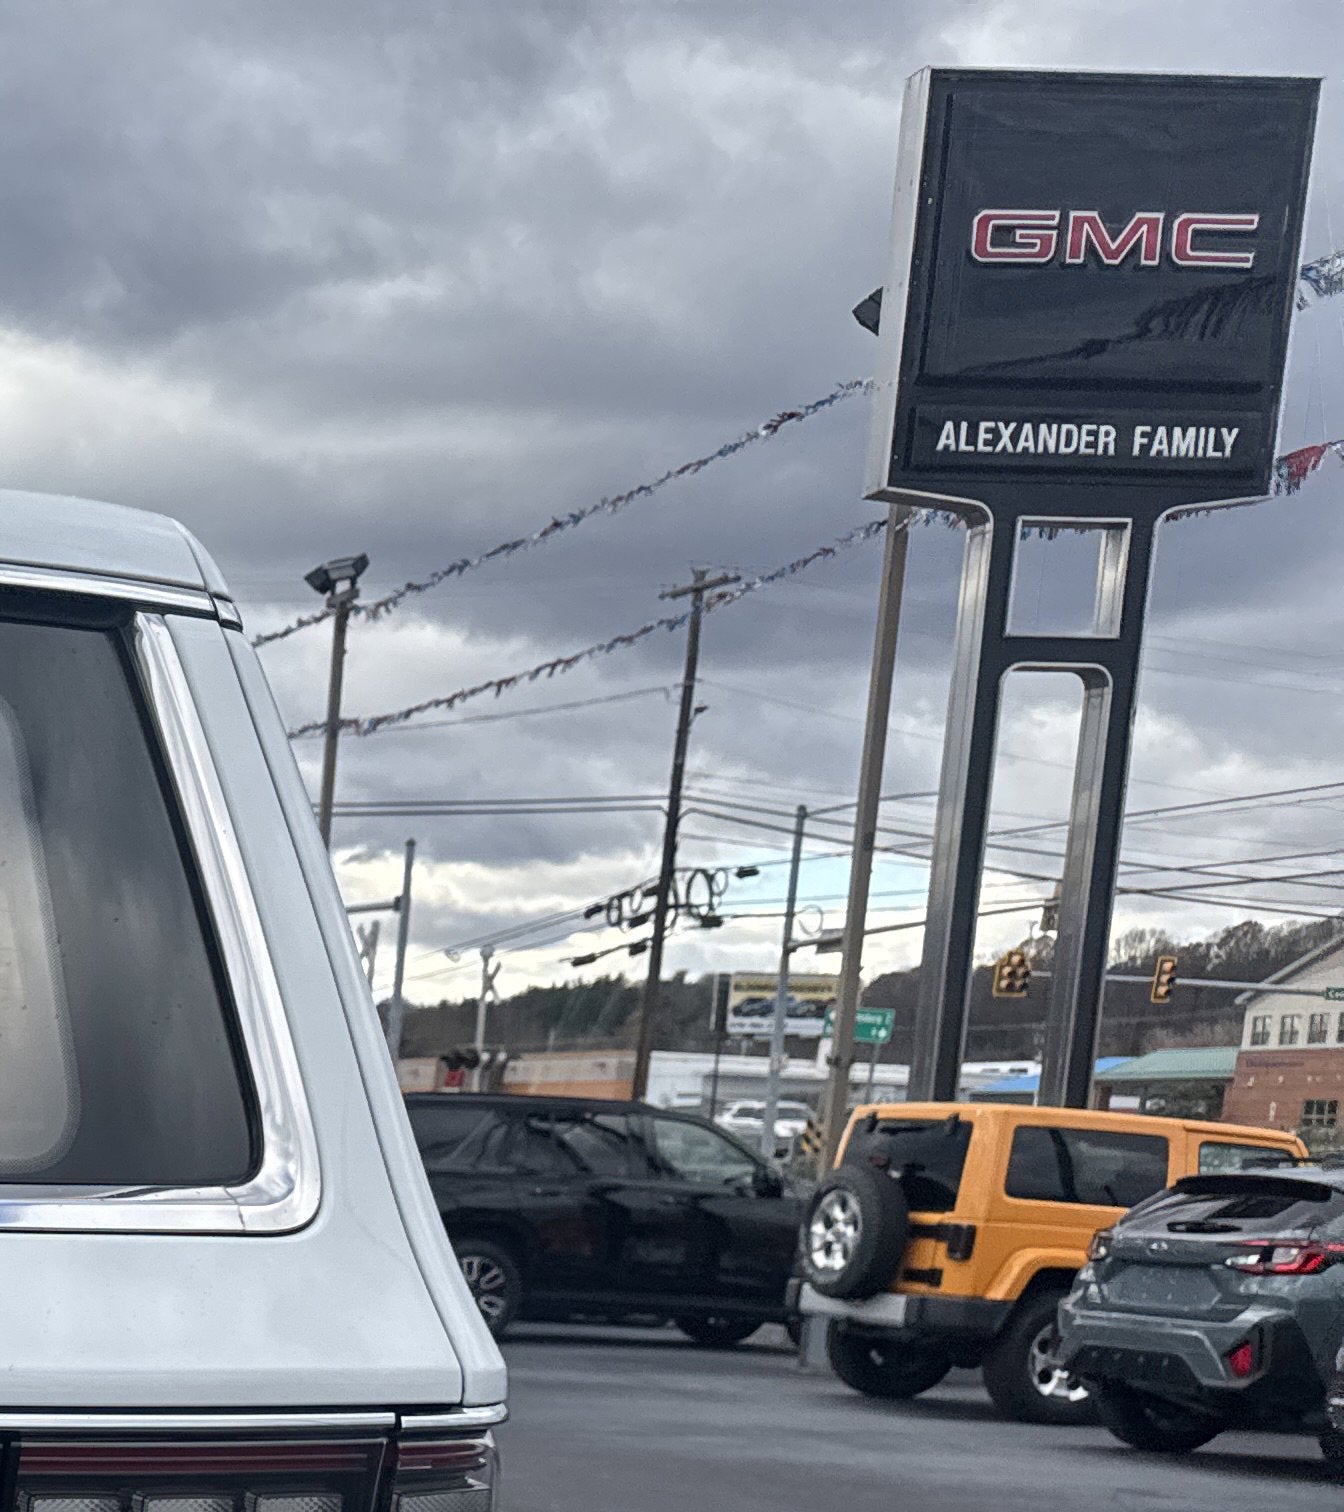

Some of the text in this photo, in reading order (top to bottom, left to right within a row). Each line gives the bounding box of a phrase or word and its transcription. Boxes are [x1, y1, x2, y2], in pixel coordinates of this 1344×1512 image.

[971, 209, 1260, 268] GMC
[936, 420, 1239, 458] ALEXANDER FAMILY
